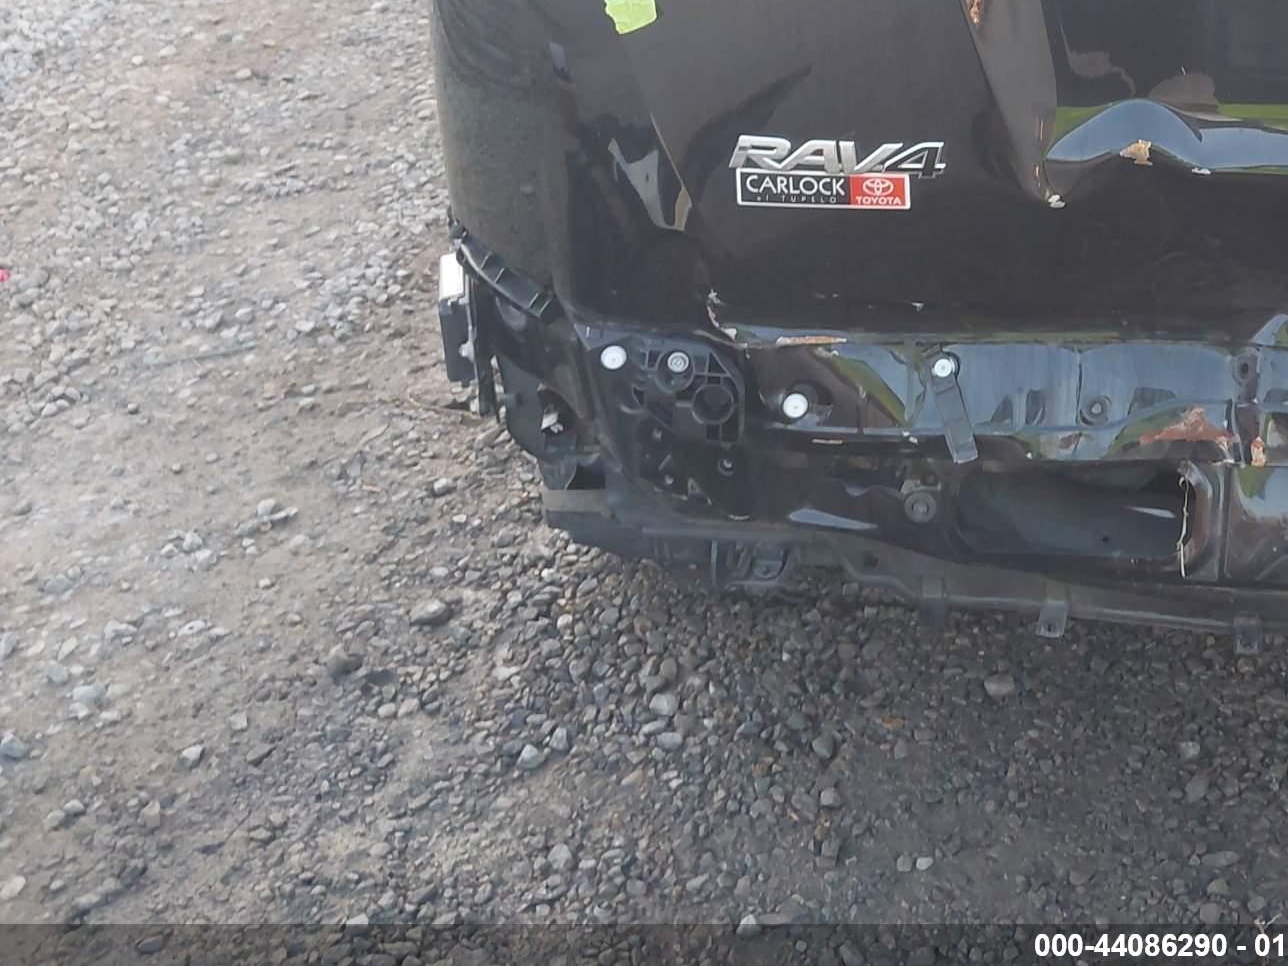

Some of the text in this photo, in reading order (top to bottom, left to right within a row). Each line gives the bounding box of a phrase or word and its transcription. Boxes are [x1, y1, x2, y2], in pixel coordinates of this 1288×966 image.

[728, 134, 947, 179] RAV4
[746, 174, 846, 196] CARLOCK
[855, 195, 903, 206] TOYOTA
